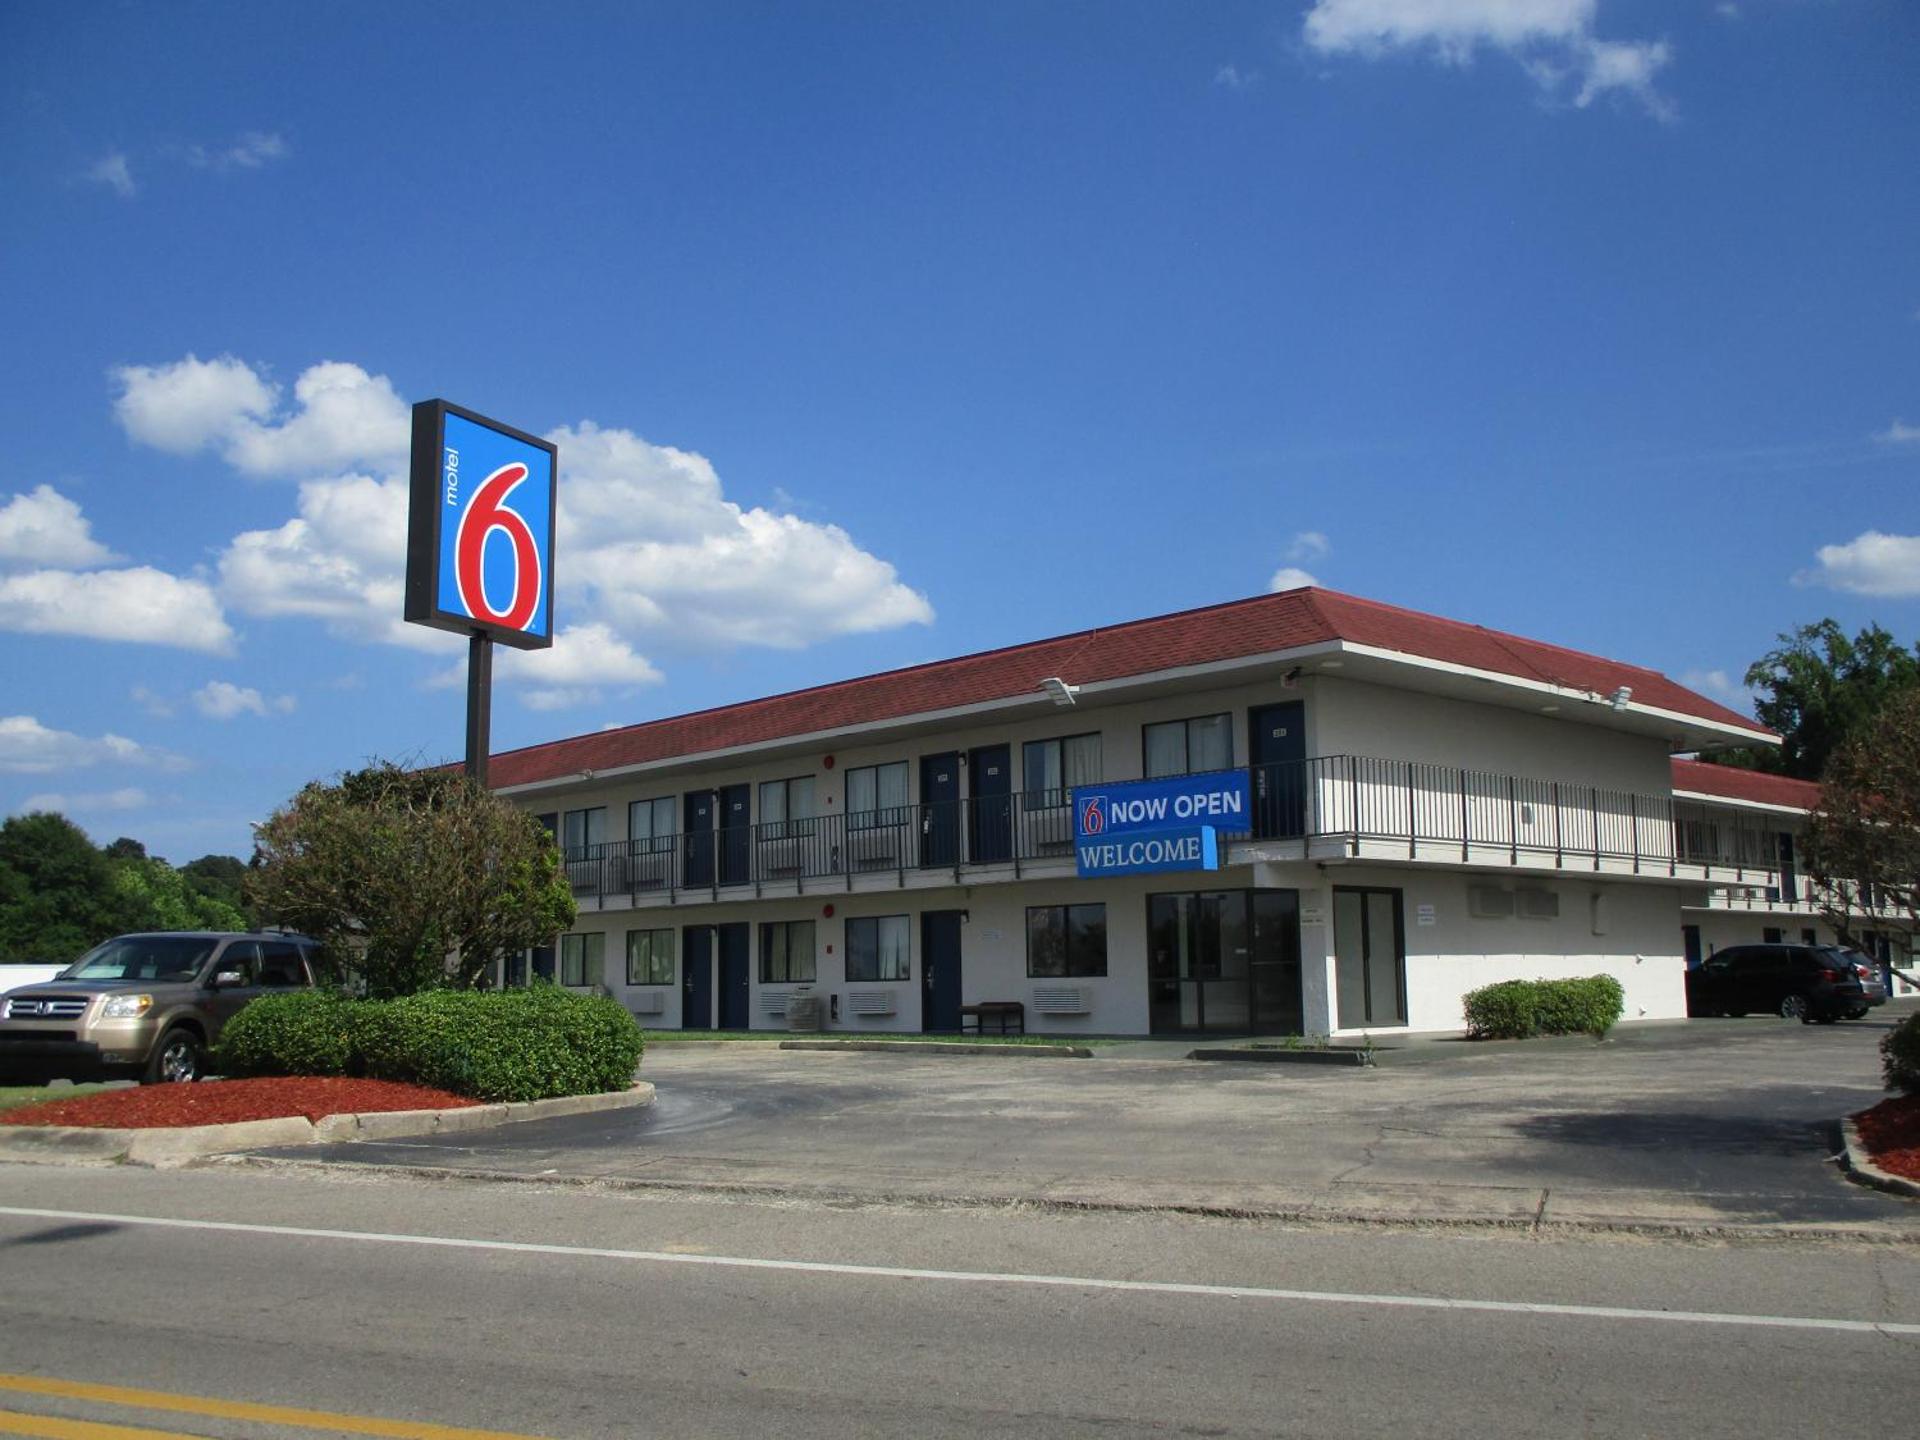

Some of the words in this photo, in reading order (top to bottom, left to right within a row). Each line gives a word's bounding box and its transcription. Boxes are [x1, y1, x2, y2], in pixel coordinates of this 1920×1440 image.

[445, 448, 459, 506] motel
[454, 462, 542, 631] 6
[1083, 798, 1103, 834] 6
[1111, 798, 1168, 824] NOW
[1174, 790, 1241, 818] OPEN
[1080, 837, 1201, 869] WELCOME
